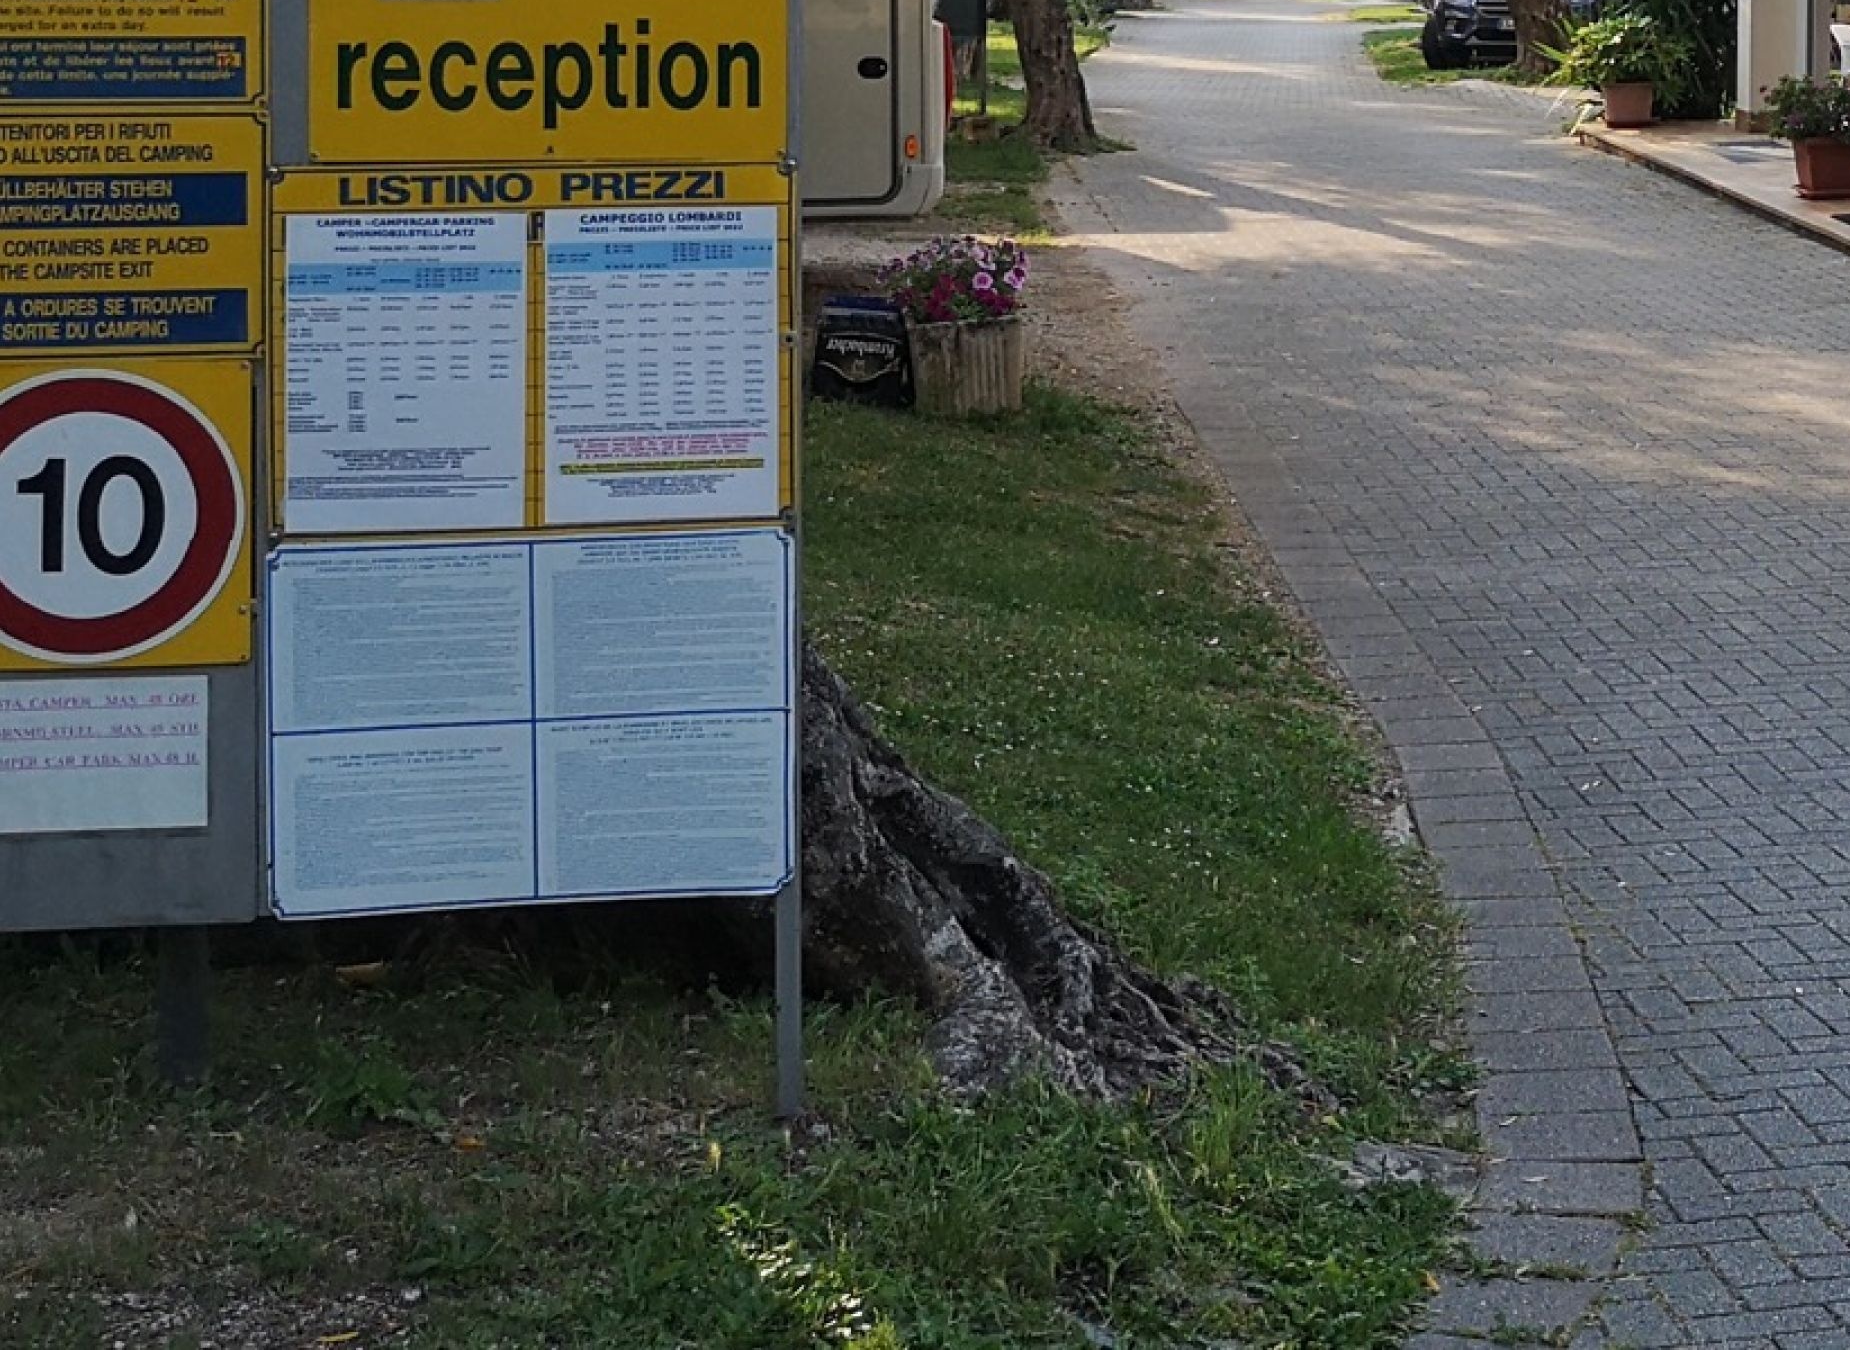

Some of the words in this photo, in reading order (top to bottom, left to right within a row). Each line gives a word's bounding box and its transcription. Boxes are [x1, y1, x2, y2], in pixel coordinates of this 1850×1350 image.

[337, 19, 760, 130] reception
[75, 123, 105, 141] PER
[119, 123, 172, 140] RIFIUTI
[12, 146, 100, 164] ALL'USCITA
[106, 146, 136, 163] DEL
[140, 144, 213, 162] CAMPING
[110, 180, 173, 199] STEHEN
[338, 173, 533, 206] LISTINO
[561, 171, 725, 200] PREZZI
[579, 213, 664, 224] CAMPEGGIO
[4, 239, 105, 258] CONTAINERS
[110, 238, 142, 255] ARE
[146, 237, 209, 254] PLACED
[33, 262, 114, 281] CAMPSITE
[119, 261, 154, 278] EXIT
[21, 299, 98, 317] ORDURES
[103, 298, 126, 315] SE
[130, 296, 217, 315] TROUVENT
[2, 323, 61, 341] SORTIE
[66, 321, 89, 338] DU
[94, 319, 170, 338] CAMPING
[16, 456, 165, 576] 10
